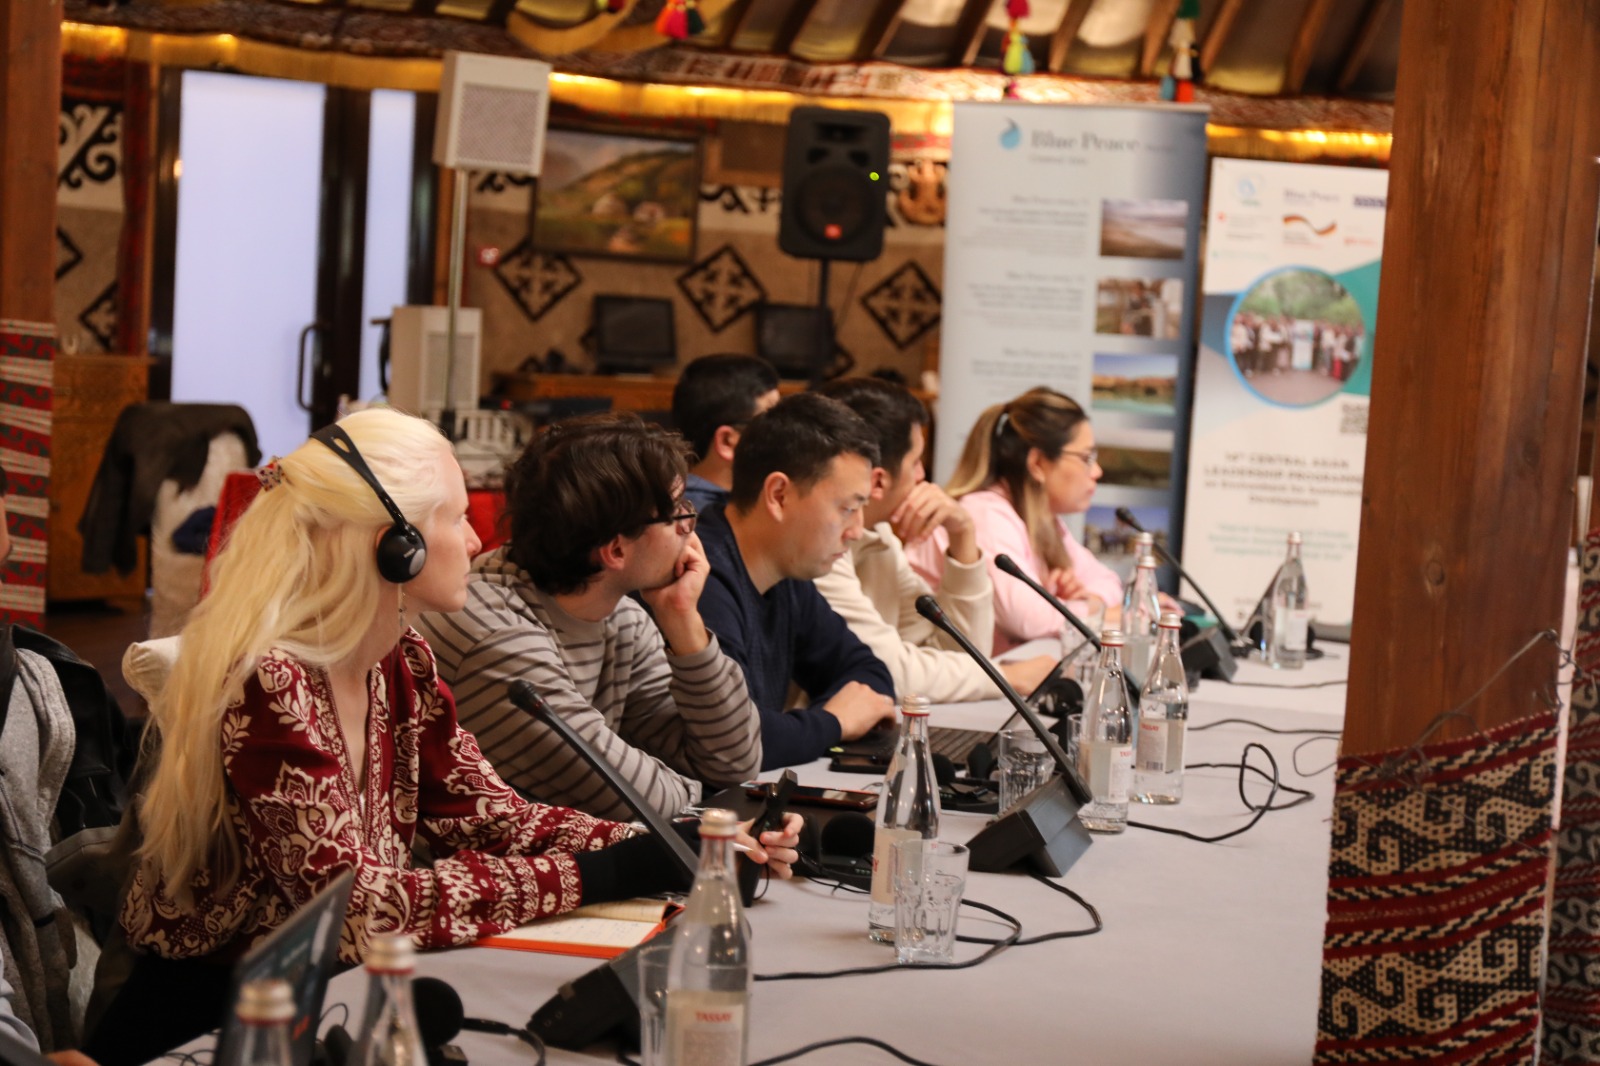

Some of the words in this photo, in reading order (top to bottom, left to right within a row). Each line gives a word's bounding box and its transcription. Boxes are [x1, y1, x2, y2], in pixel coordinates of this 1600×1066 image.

[1031, 129, 1077, 148] Blue
[1081, 132, 1140, 150] Peace
[695, 1011, 733, 1022] TASSAY
